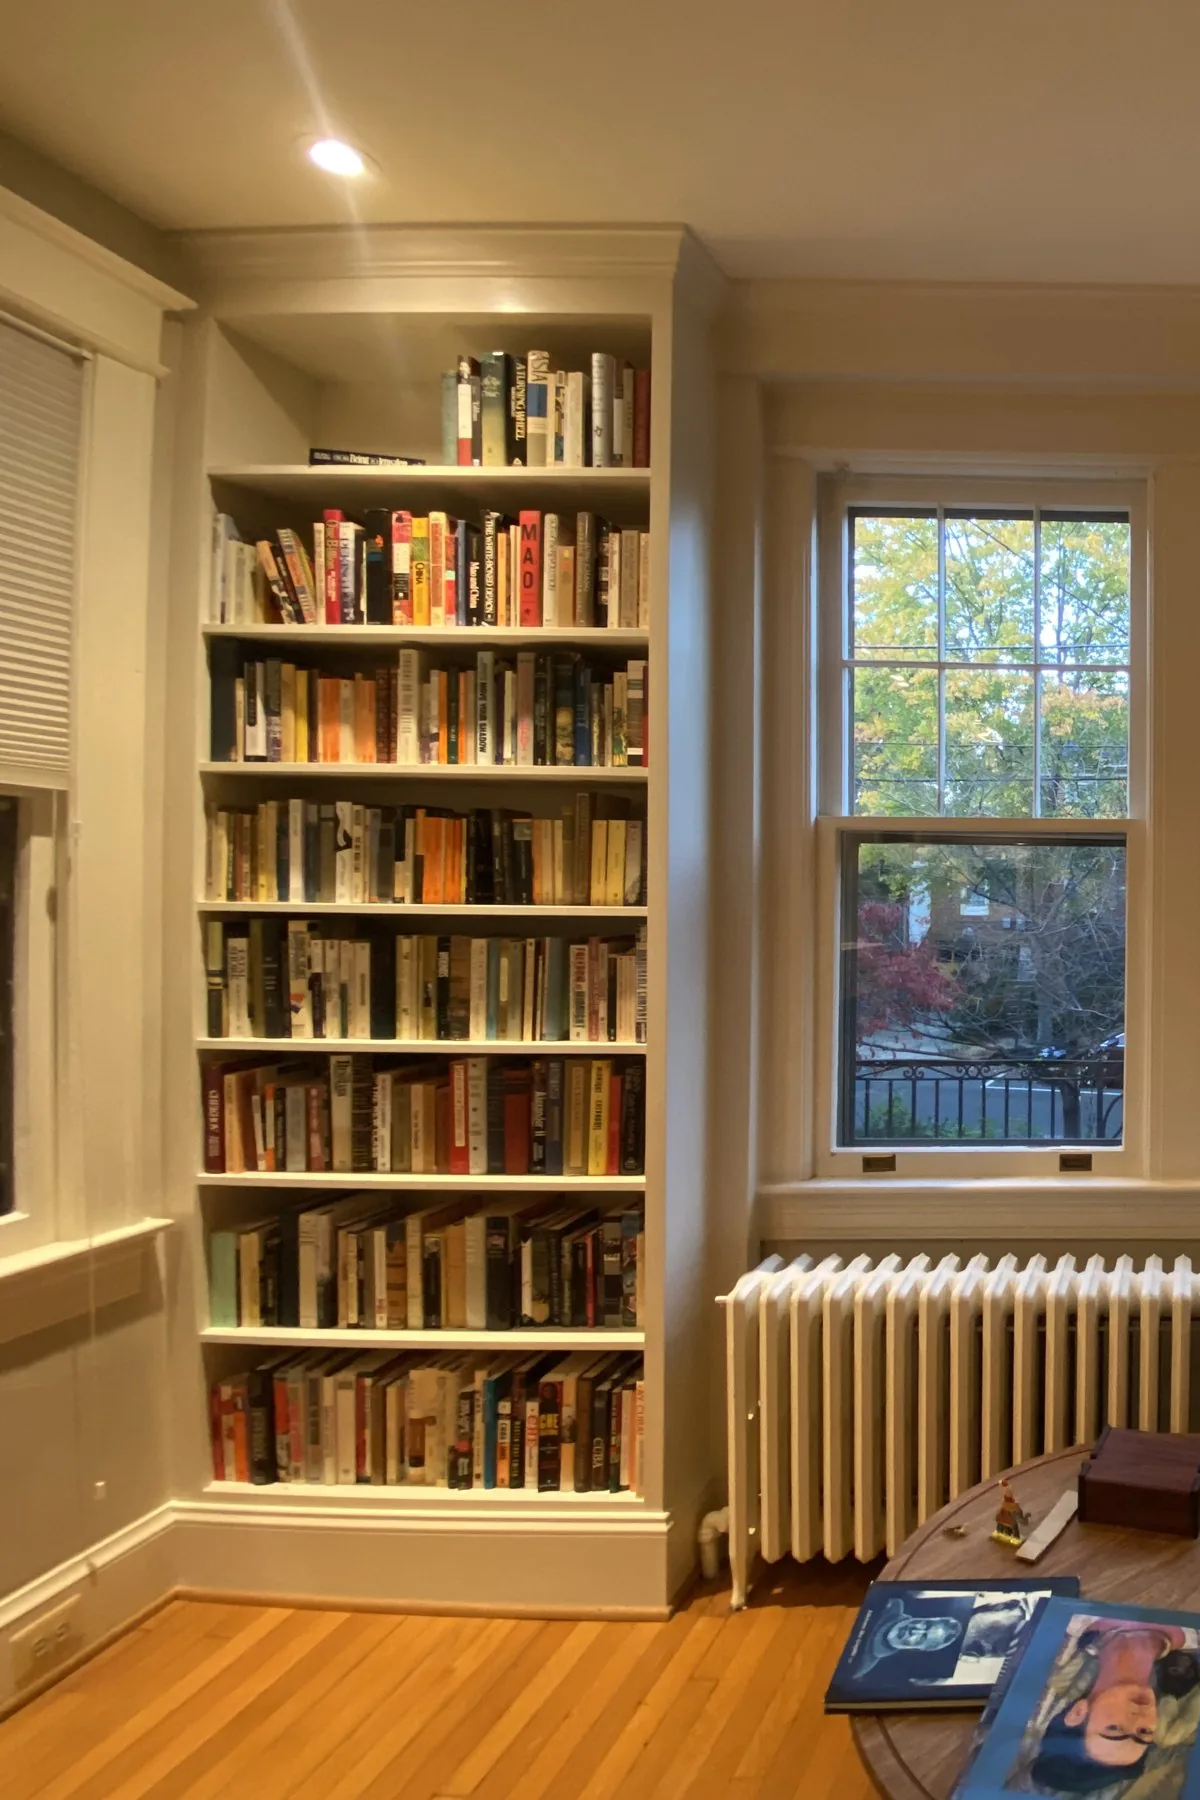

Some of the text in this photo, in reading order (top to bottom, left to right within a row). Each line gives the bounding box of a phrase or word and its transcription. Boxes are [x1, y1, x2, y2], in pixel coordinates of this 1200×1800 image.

[515, 371, 527, 409] TURNING
[486, 518, 496, 533] THE
[470, 560, 480, 573] Mao
[521, 523, 538, 590] MAO
[415, 562, 426, 584] CHINA
[470, 586, 480, 609] China
[484, 587, 495, 612] DEMON
[479, 682, 489, 702] MOVE
[478, 724, 488, 754] SHADOW
[575, 947, 587, 983] FREEDOM
[636, 991, 648, 1023] COMPANY
[532, 1090, 547, 1129] Alexander
[592, 1436, 605, 1469] CUBA
